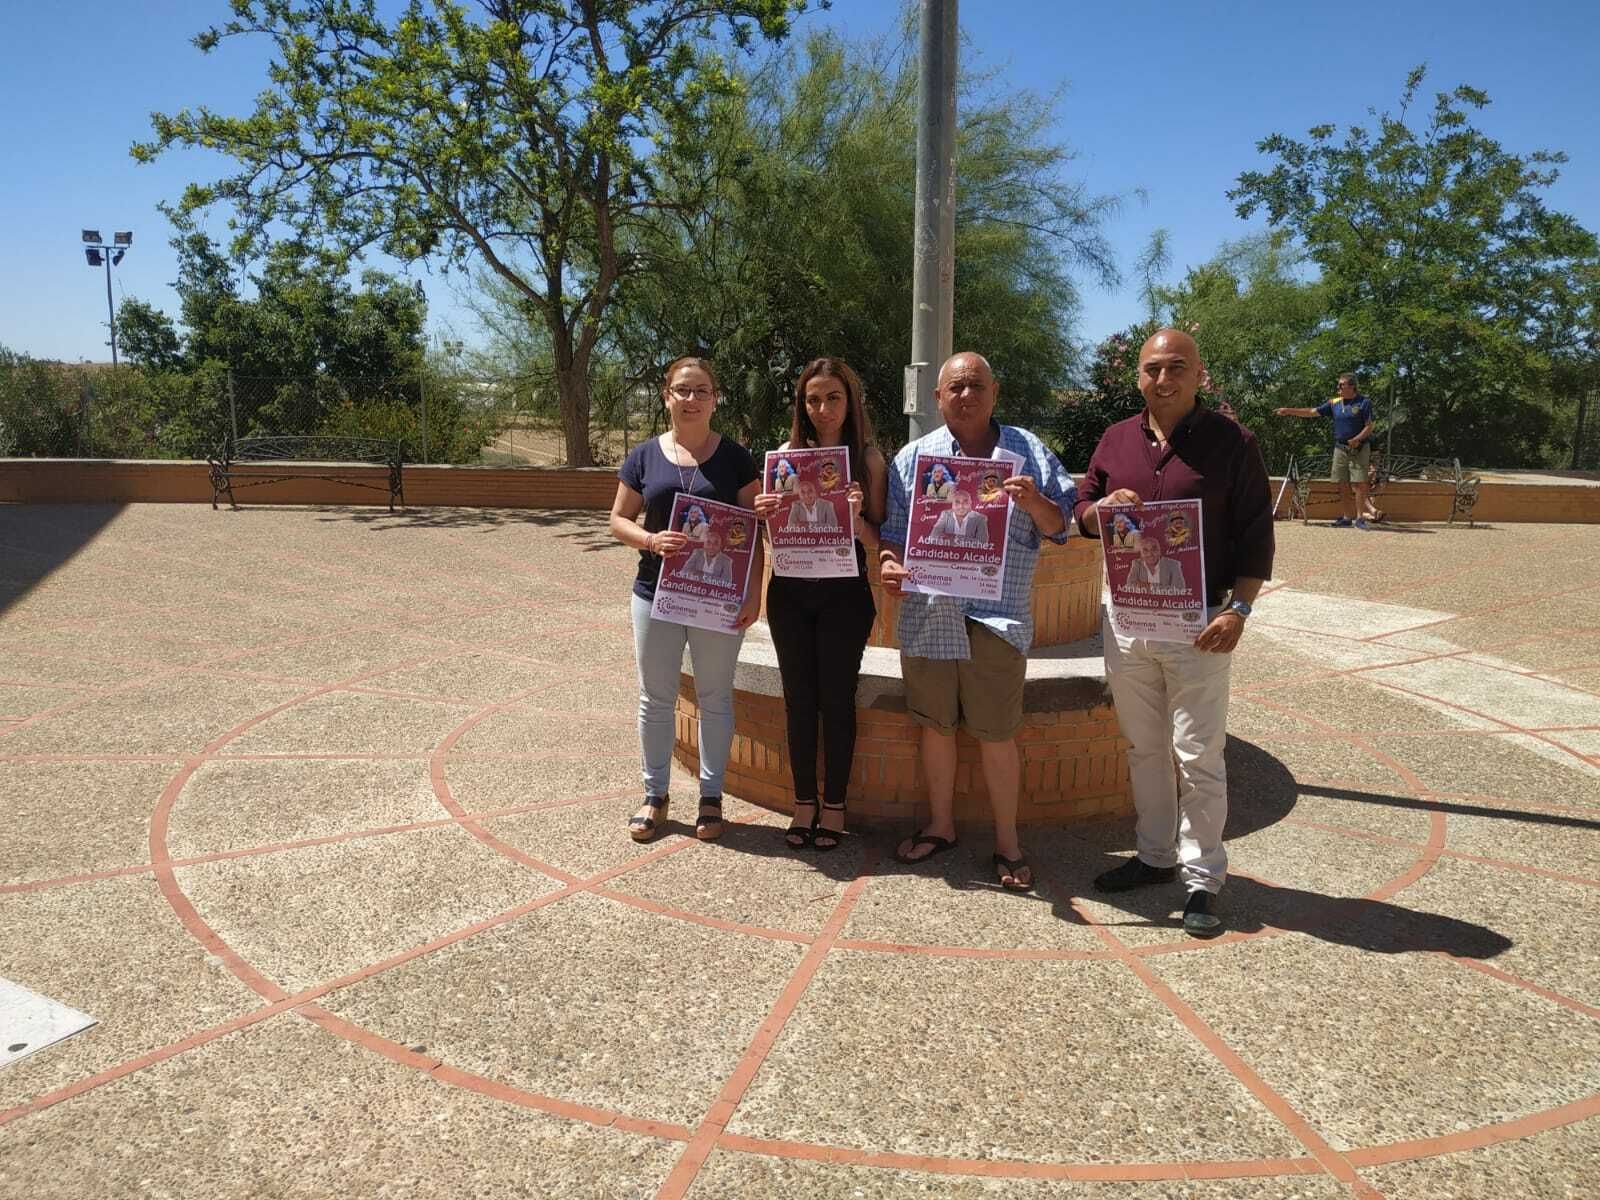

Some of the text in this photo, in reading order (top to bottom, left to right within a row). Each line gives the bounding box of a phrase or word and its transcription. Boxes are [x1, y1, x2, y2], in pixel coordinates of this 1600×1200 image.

[773, 535, 851, 545] Candidato Alcalde
[909, 547, 1001, 564] Candidato Alcalde
[661, 578, 707, 595] Candidato
[711, 588, 742, 602] Alcalde
[1113, 593, 1202, 609] Candidato Alcalde
